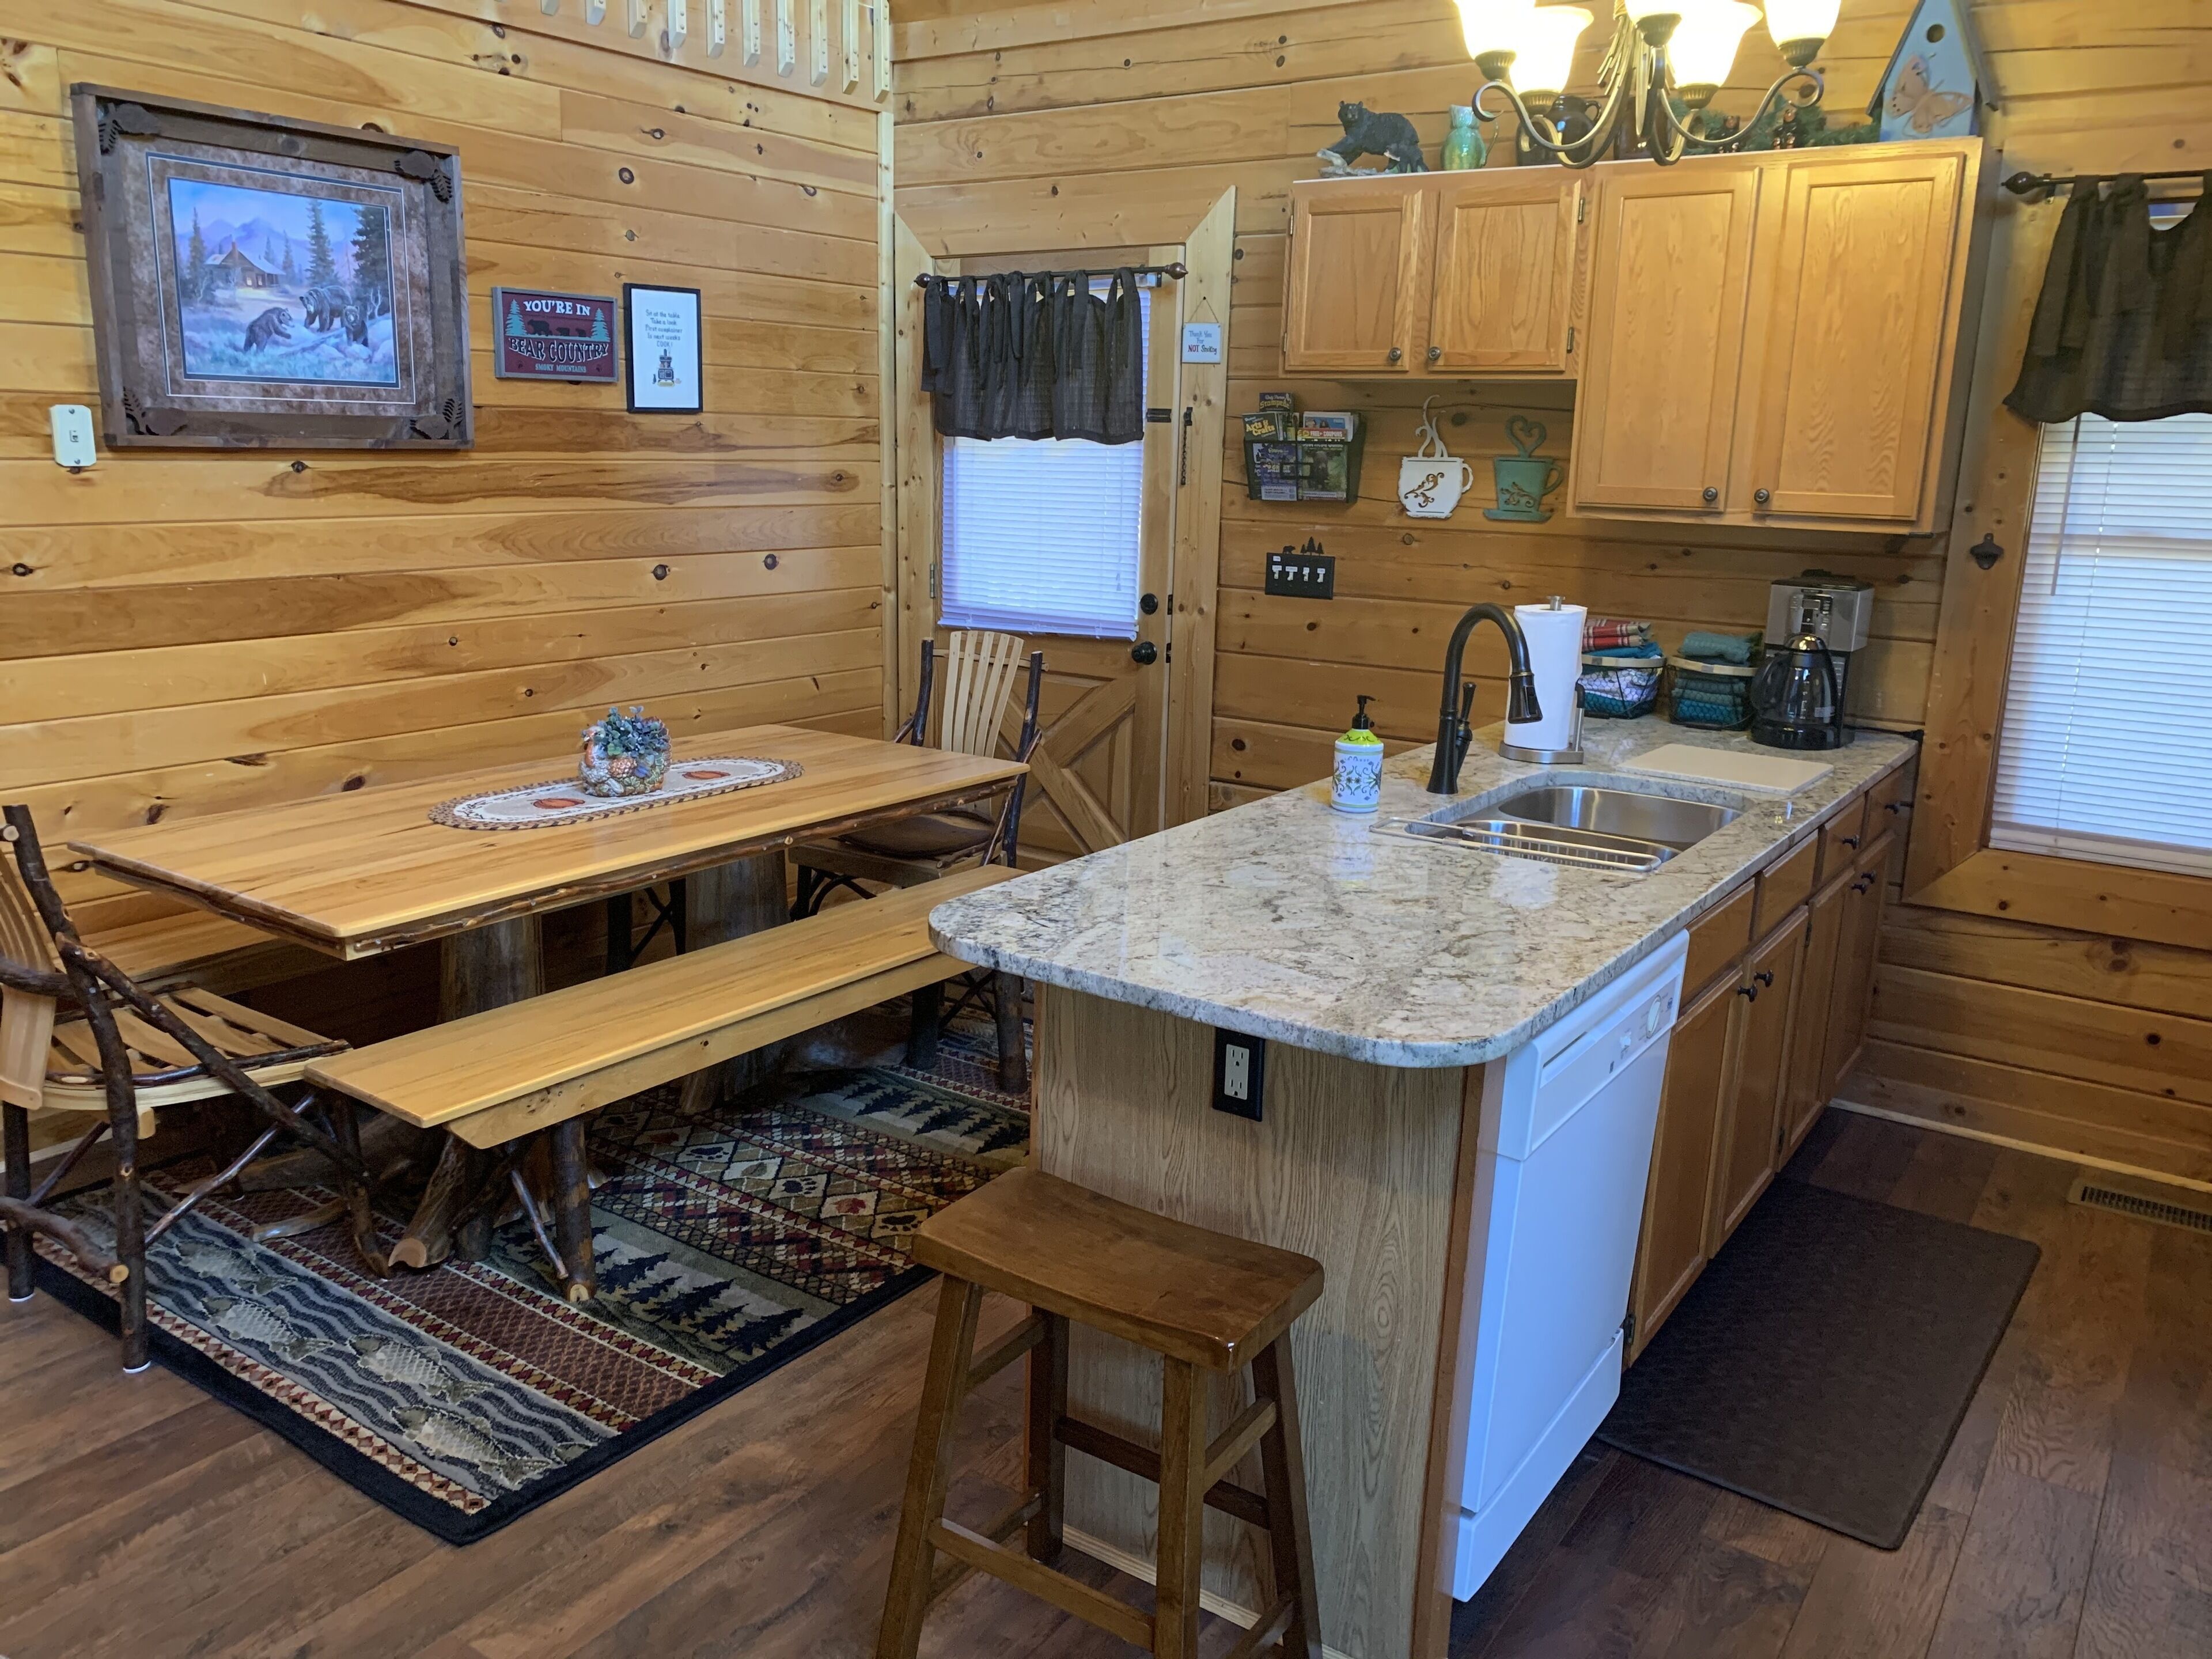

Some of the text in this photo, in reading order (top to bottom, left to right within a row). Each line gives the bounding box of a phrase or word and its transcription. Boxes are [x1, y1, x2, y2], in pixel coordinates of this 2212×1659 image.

[523, 300, 591, 316] YOU'RE IN
[645, 324, 657, 332] First
[509, 338, 609, 363] BEAR COUNTRY
[1187, 344, 1217, 355] NOT Smoking
[535, 363, 586, 373] SMOKY MOUNTAINS
